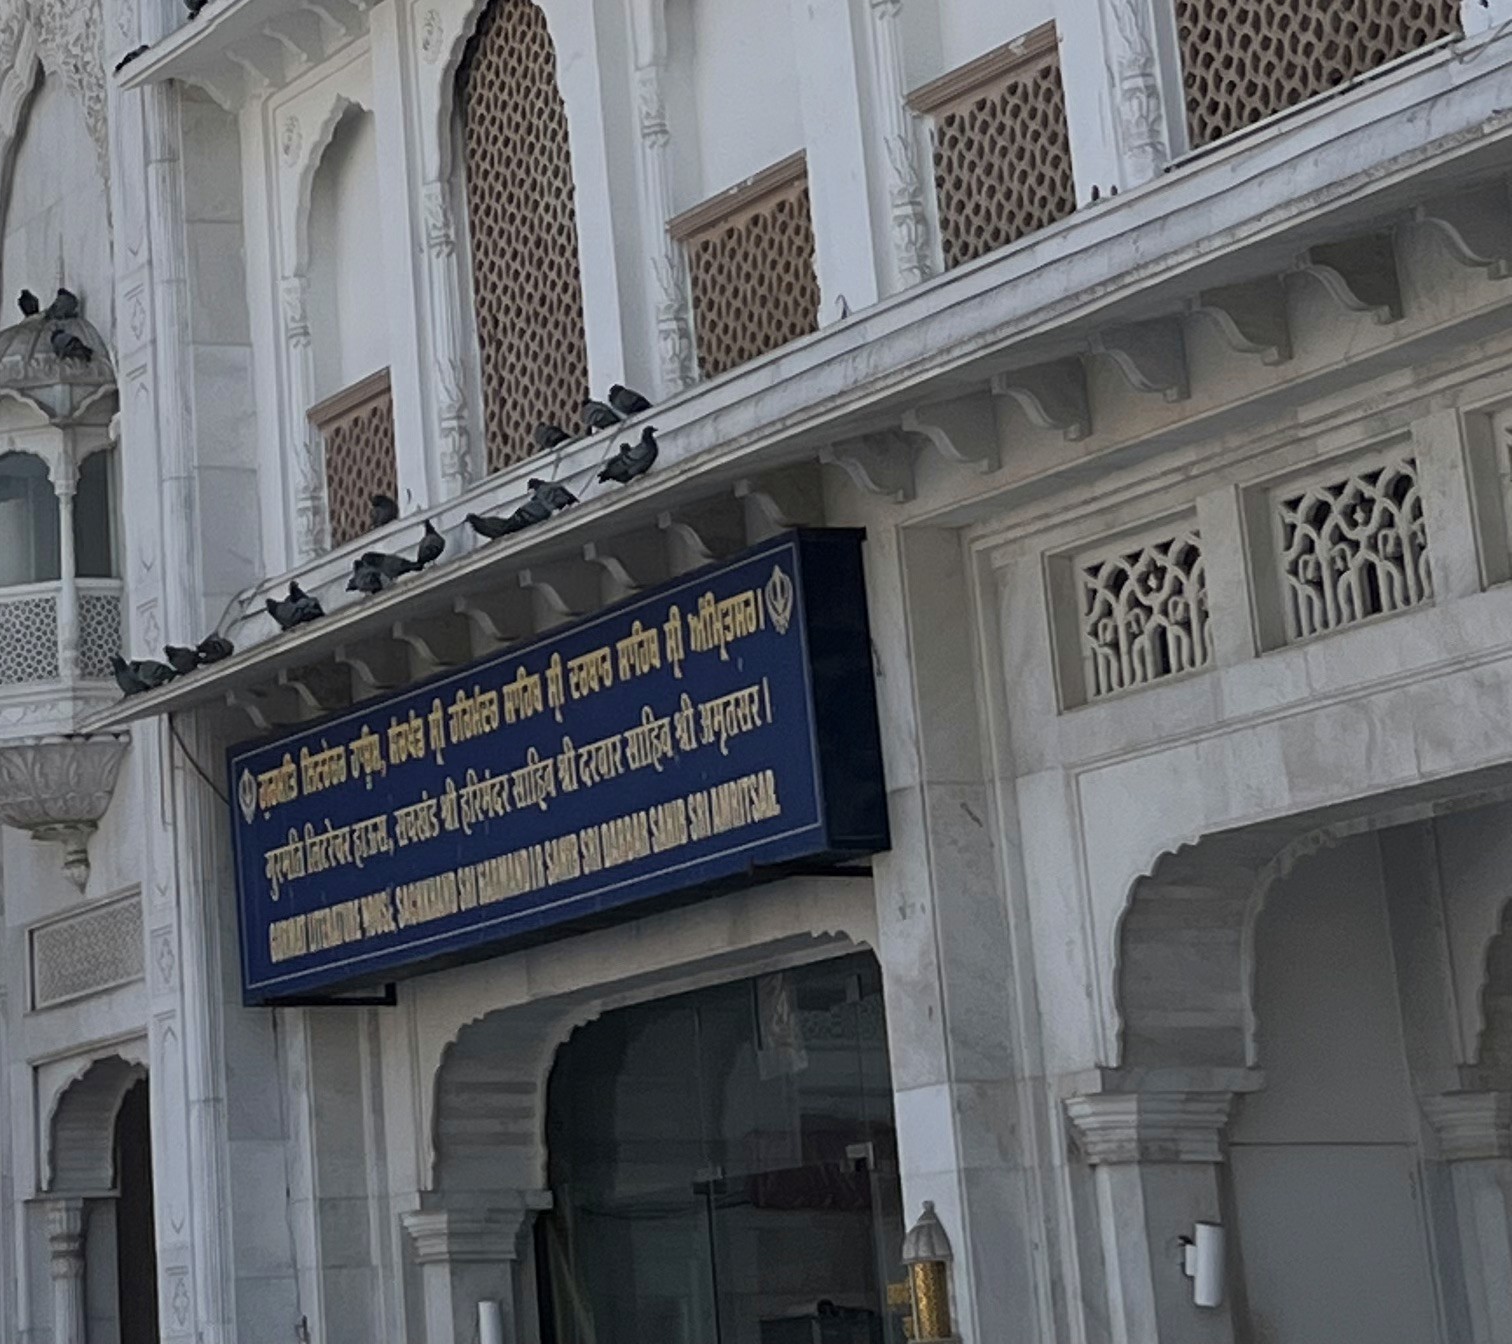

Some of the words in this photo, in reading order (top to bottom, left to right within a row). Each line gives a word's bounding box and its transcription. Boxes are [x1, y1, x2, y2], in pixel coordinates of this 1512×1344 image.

[429, 698, 445, 765] ਸ੍ਰੀ
[546, 652, 564, 723] ਸ੍ਰੀ
[568, 646, 612, 700] ਦਰਬਾਰ
[617, 620, 660, 681] ਸਾਹਿਬ
[664, 605, 684, 678] ਸ੍ਰੀ
[440, 777, 459, 831] श्री
[558, 736, 578, 792] श्री
[674, 692, 697, 751] श्री
[458, 865, 477, 912] SRI
[580, 825, 602, 875] SRI
[688, 790, 711, 841] SRI
